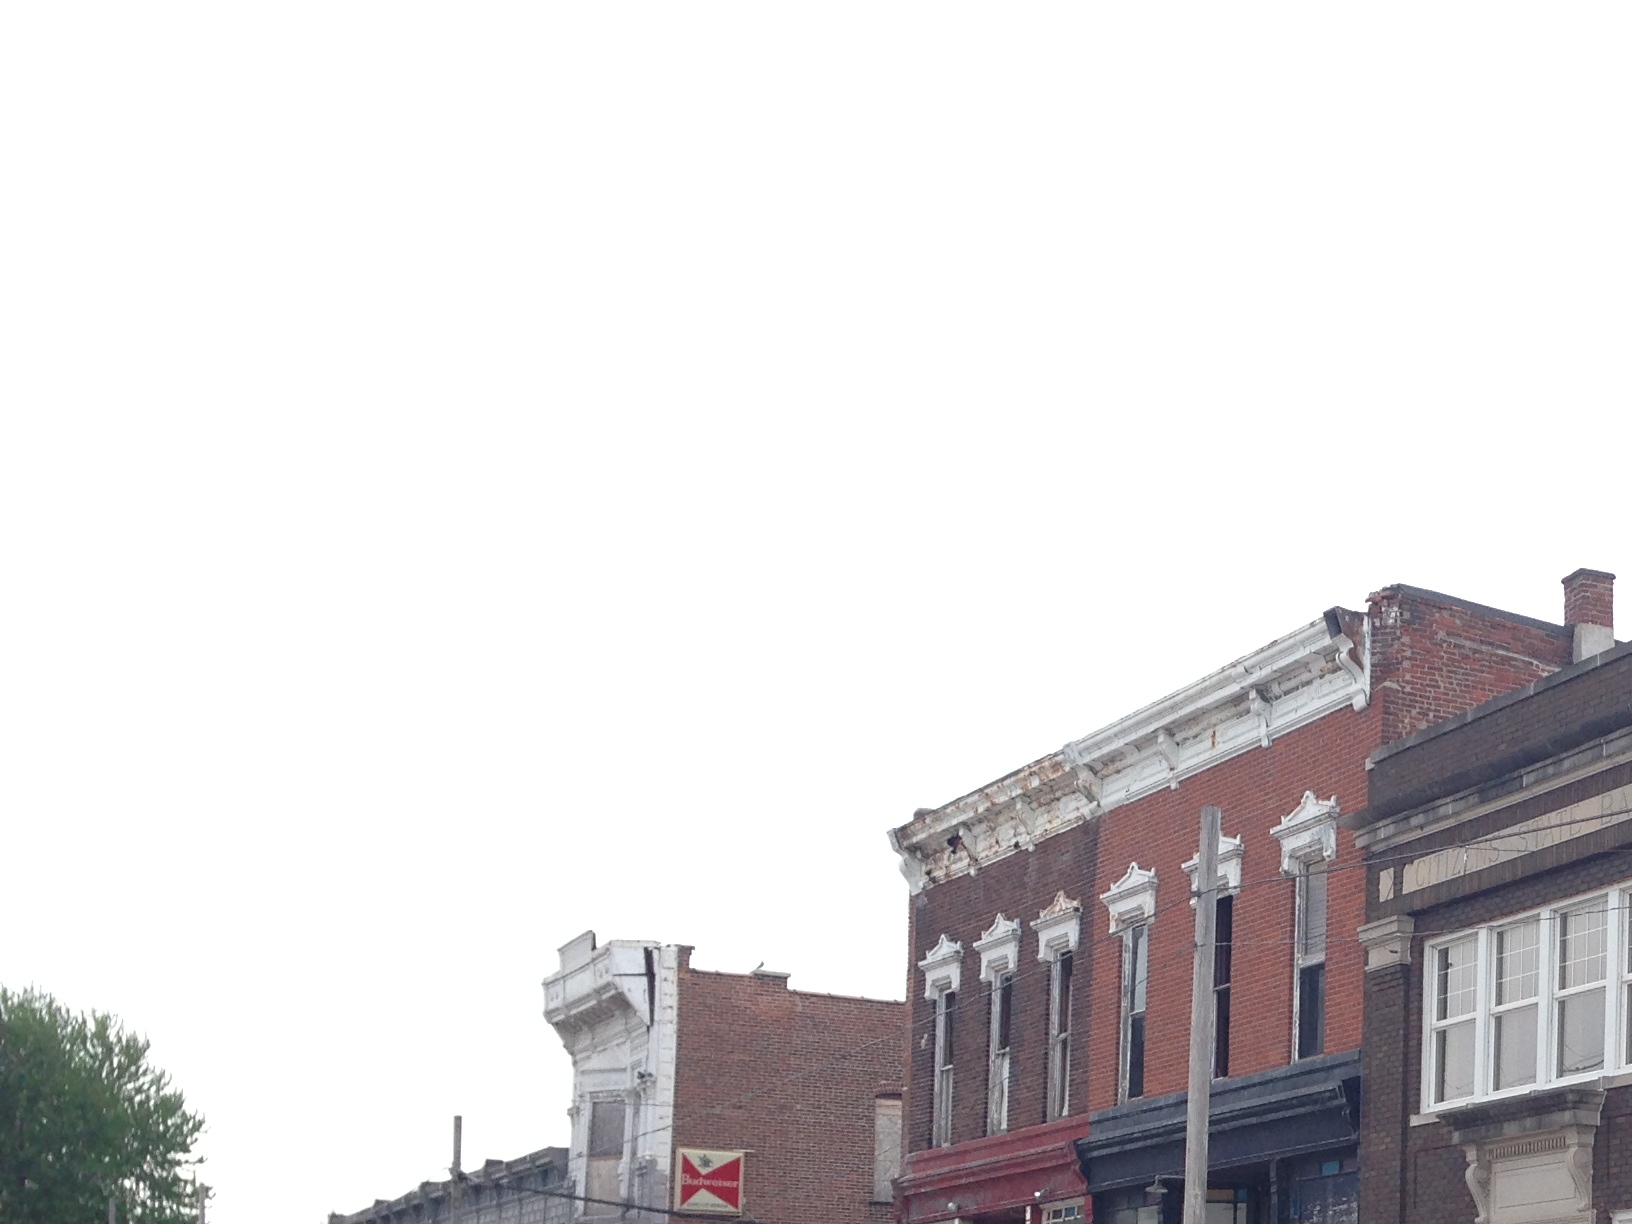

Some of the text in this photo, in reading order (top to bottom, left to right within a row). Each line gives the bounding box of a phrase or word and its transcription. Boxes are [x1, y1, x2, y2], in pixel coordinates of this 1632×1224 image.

[1415, 838, 1500, 887] CITIZENS
[1517, 805, 1582, 851] STATE
[681, 1173, 739, 1188] Budweiser
